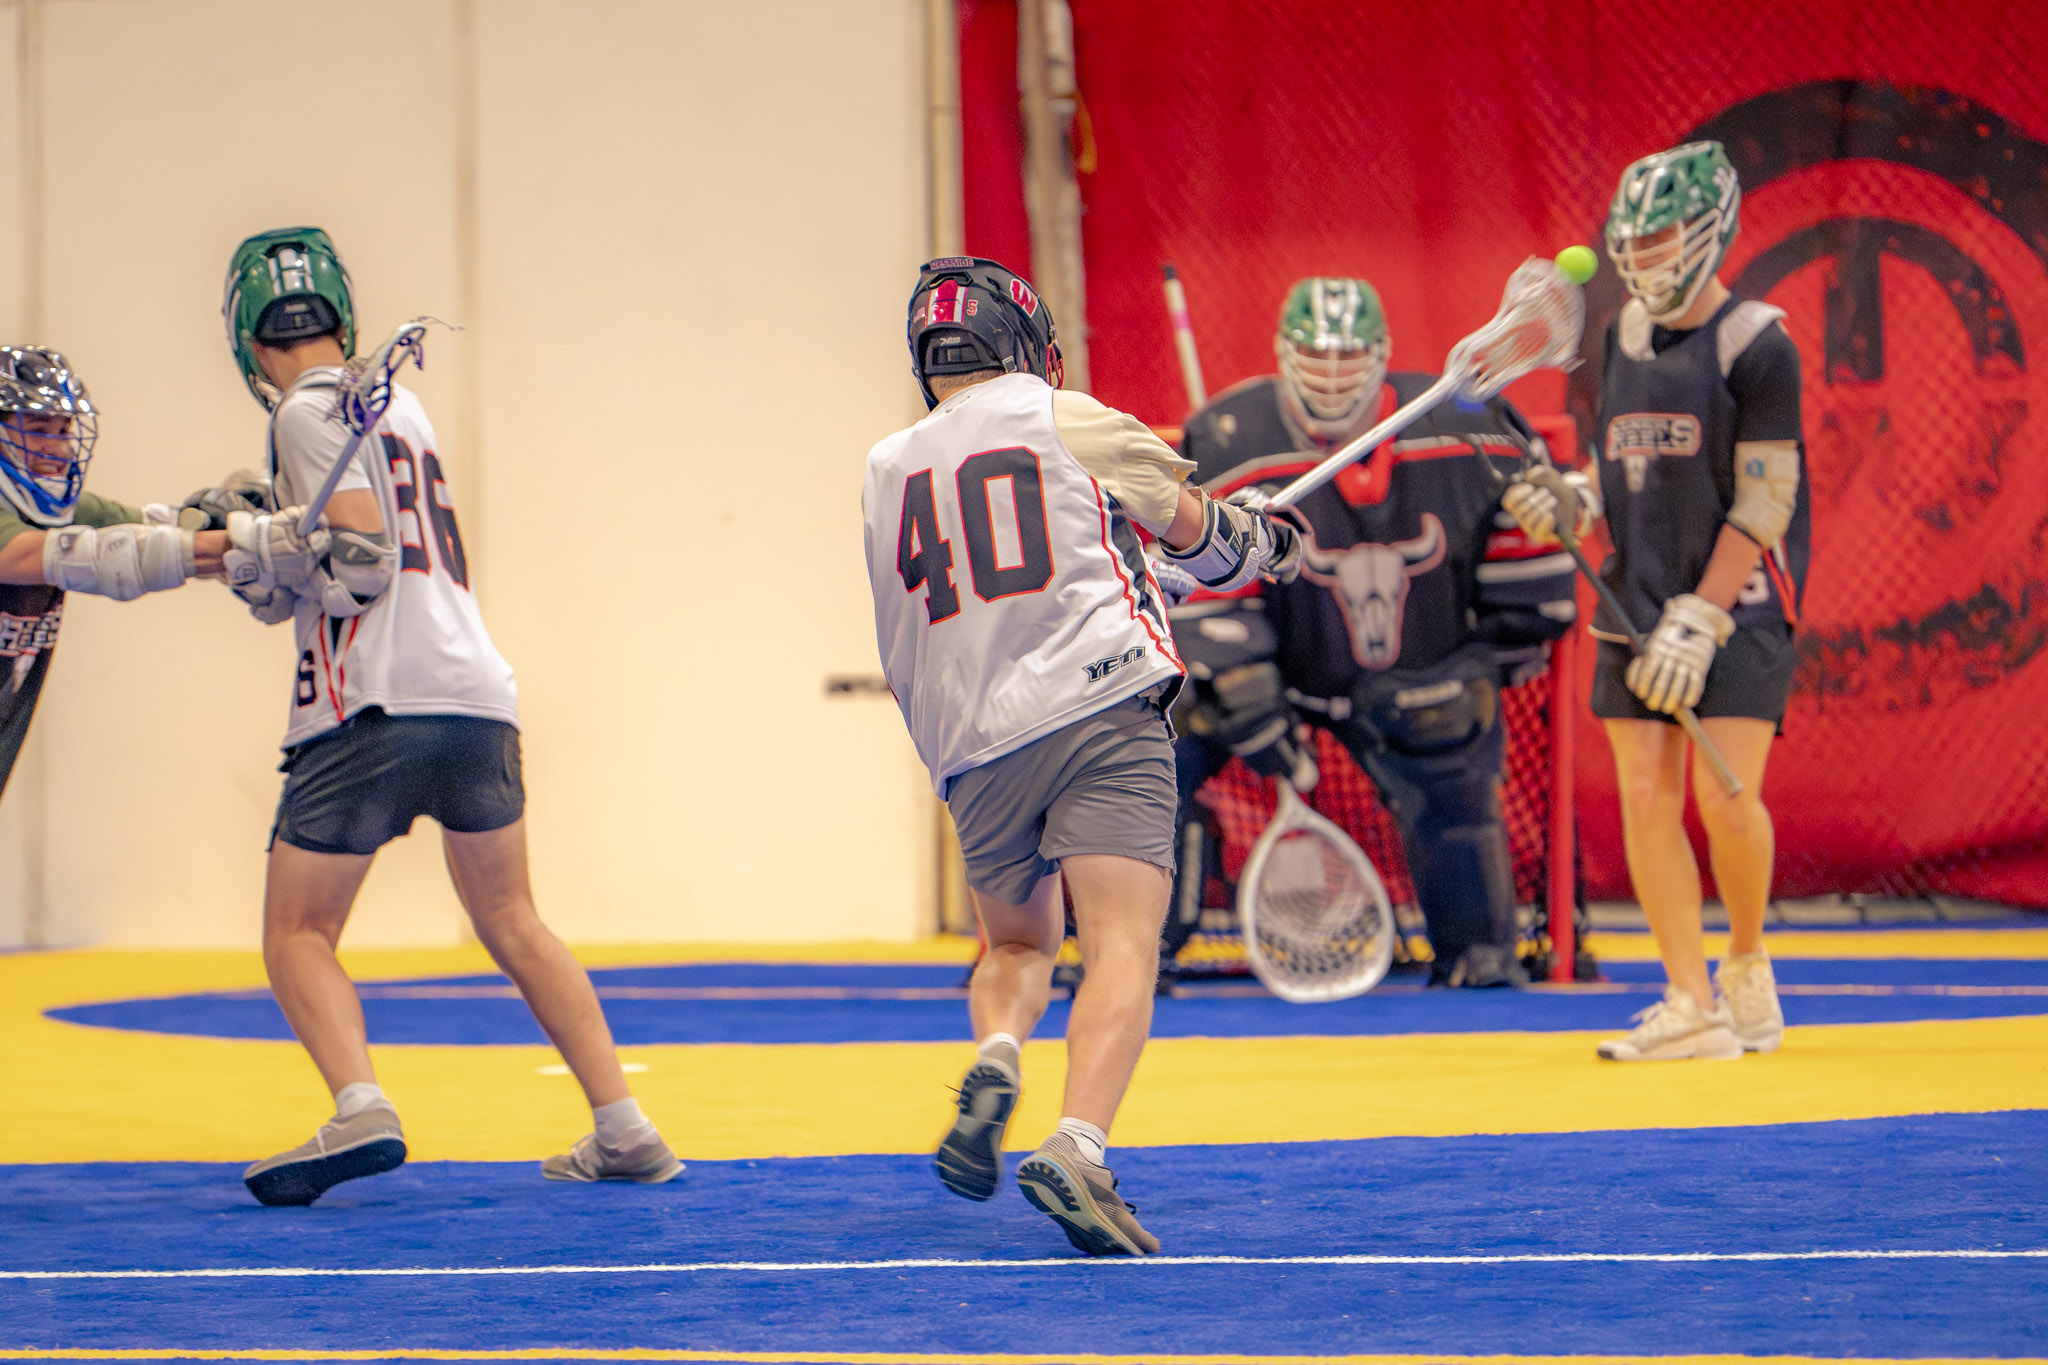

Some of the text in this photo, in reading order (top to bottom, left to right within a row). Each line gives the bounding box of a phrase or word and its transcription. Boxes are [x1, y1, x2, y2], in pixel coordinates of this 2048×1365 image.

[1010, 279, 1038, 317] W
[897, 446, 1055, 626] 40
[1082, 646, 1145, 682] YETI
